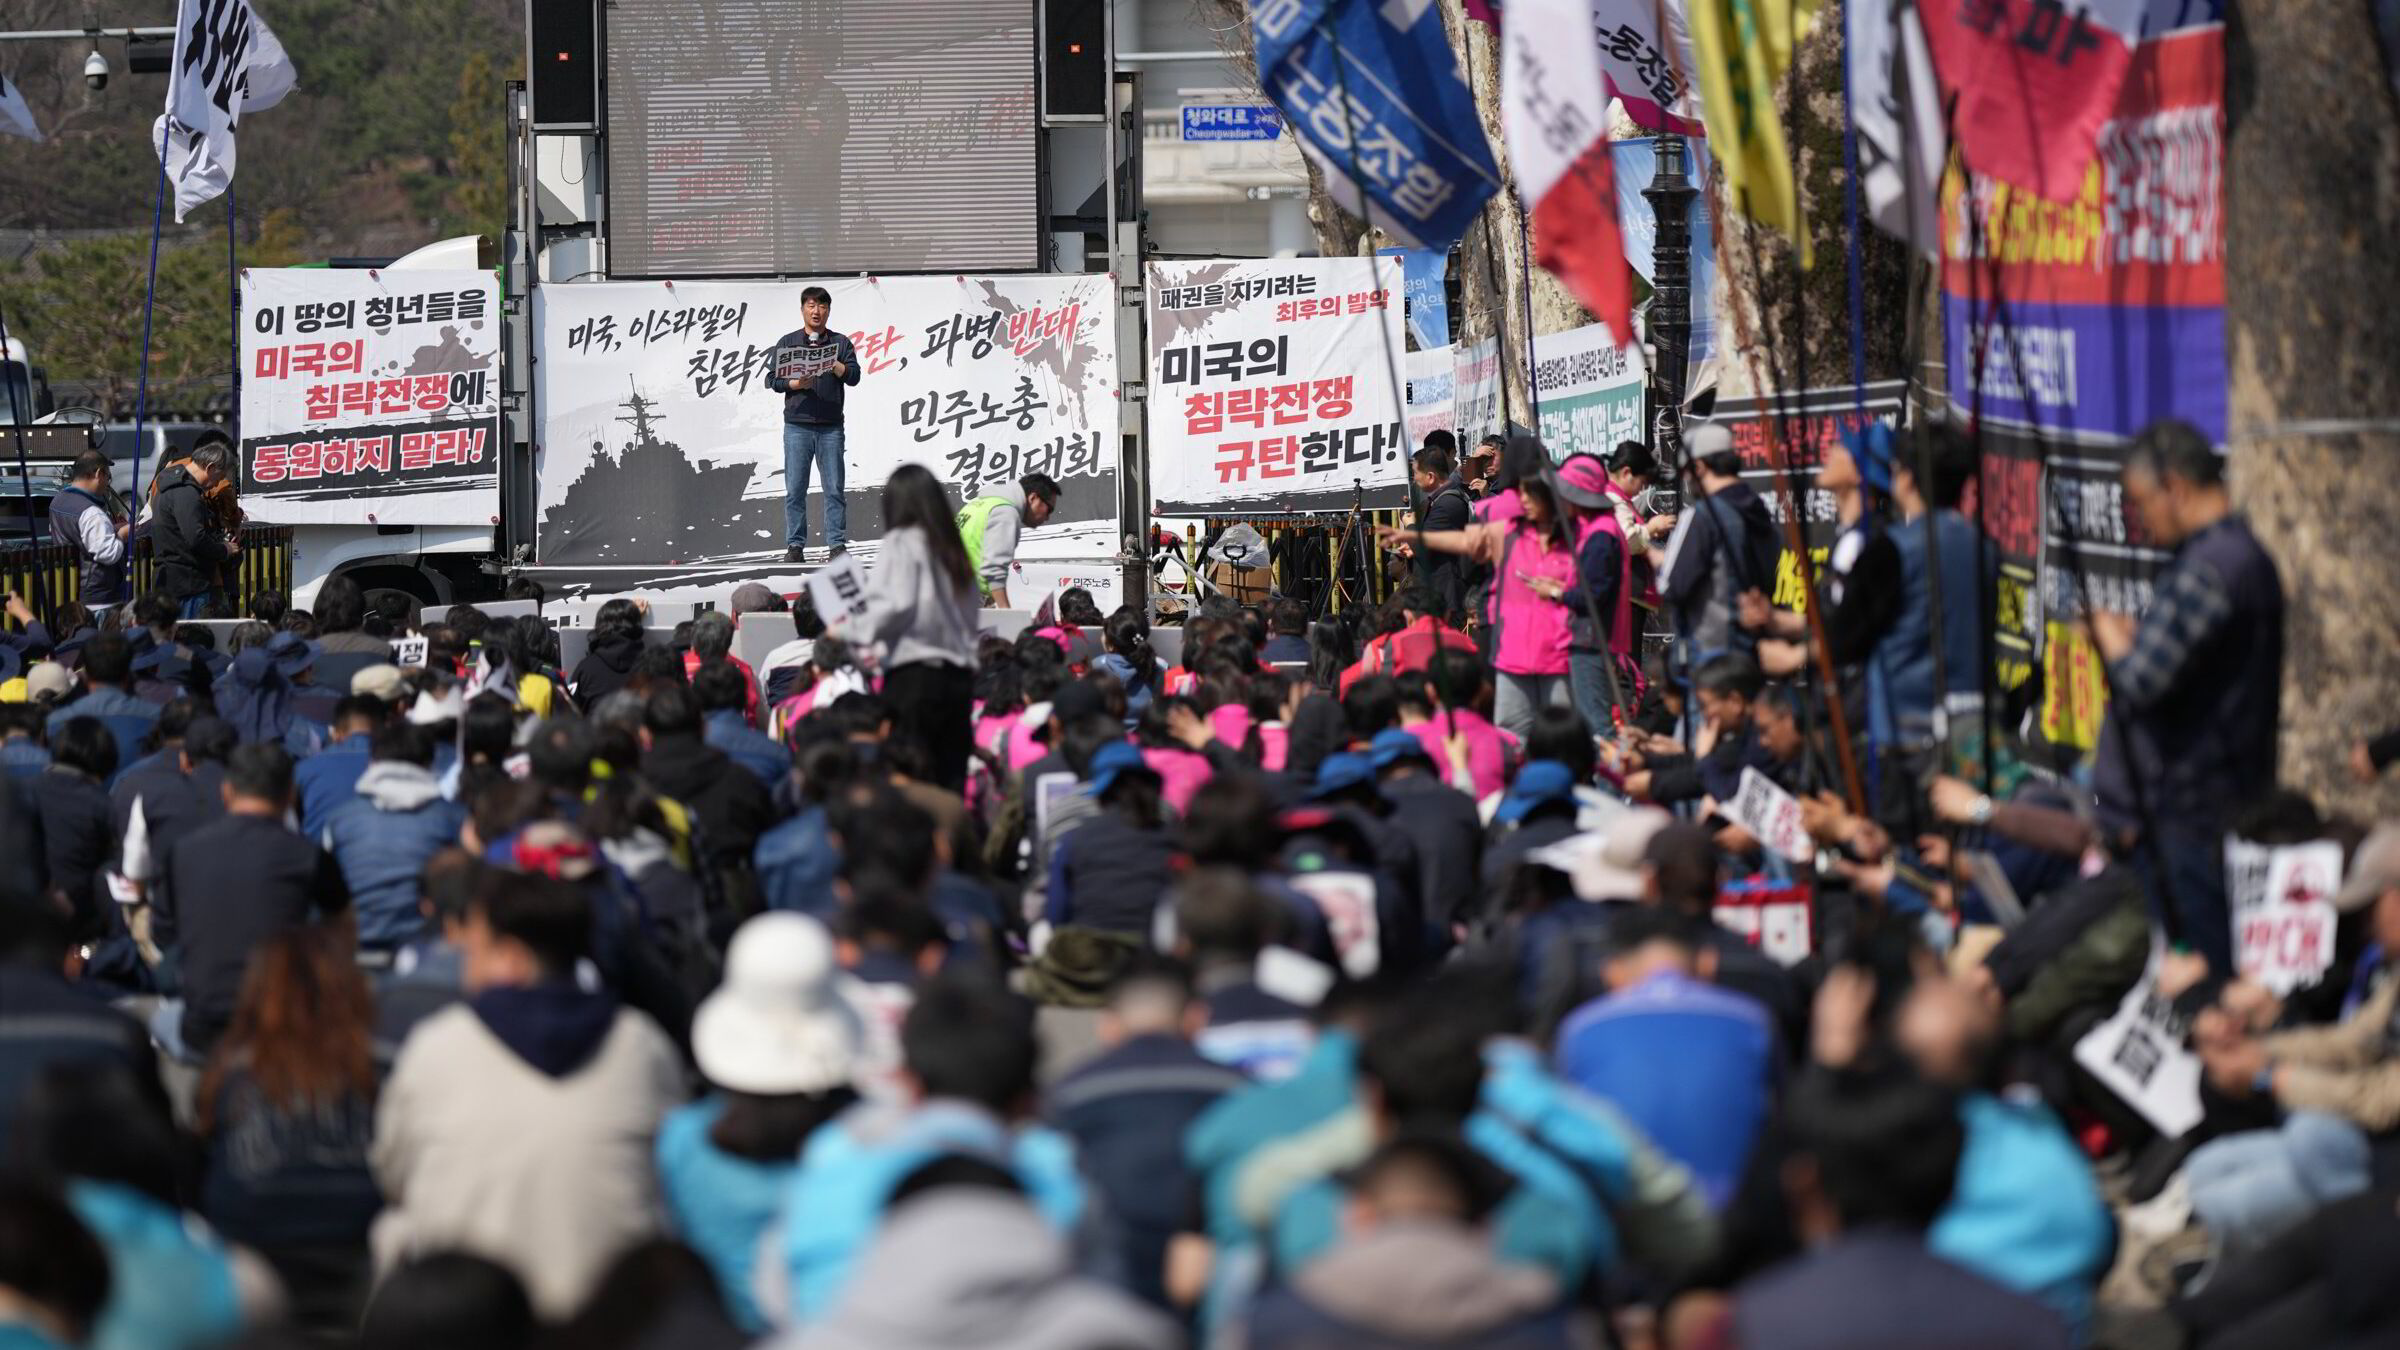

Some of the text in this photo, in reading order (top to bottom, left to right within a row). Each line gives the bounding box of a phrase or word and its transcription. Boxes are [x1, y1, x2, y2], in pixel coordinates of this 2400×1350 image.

[1186, 108, 1249, 127] 청와대로
[1279, 46, 1454, 221] 노동조합
[255, 289, 487, 335] 이 땅의 청년들을
[1159, 273, 1317, 309] 패권을 지키려는
[1275, 289, 1390, 322] 최후의 발악
[568, 302, 748, 355] 미국, 이스라엘의
[686, 345, 776, 398] 침략
[920, 311, 1002, 367] 파병
[1008, 303, 1081, 361] 반대
[255, 340, 364, 379] 미국의
[777, 359, 836, 378] 미국규탄
[778, 344, 837, 365] 침략전쟁
[1162, 335, 1289, 385] 미국의
[305, 371, 486, 421] 침략전쟁에
[901, 376, 1048, 442] 민주노총
[1184, 375, 1354, 435] 침략전쟁
[252, 429, 486, 482] 동원하지 말라!
[946, 431, 1101, 500] 결의대회
[1214, 422, 1400, 484] 규탄한다!
[1073, 577, 1111, 589] 민주노총
